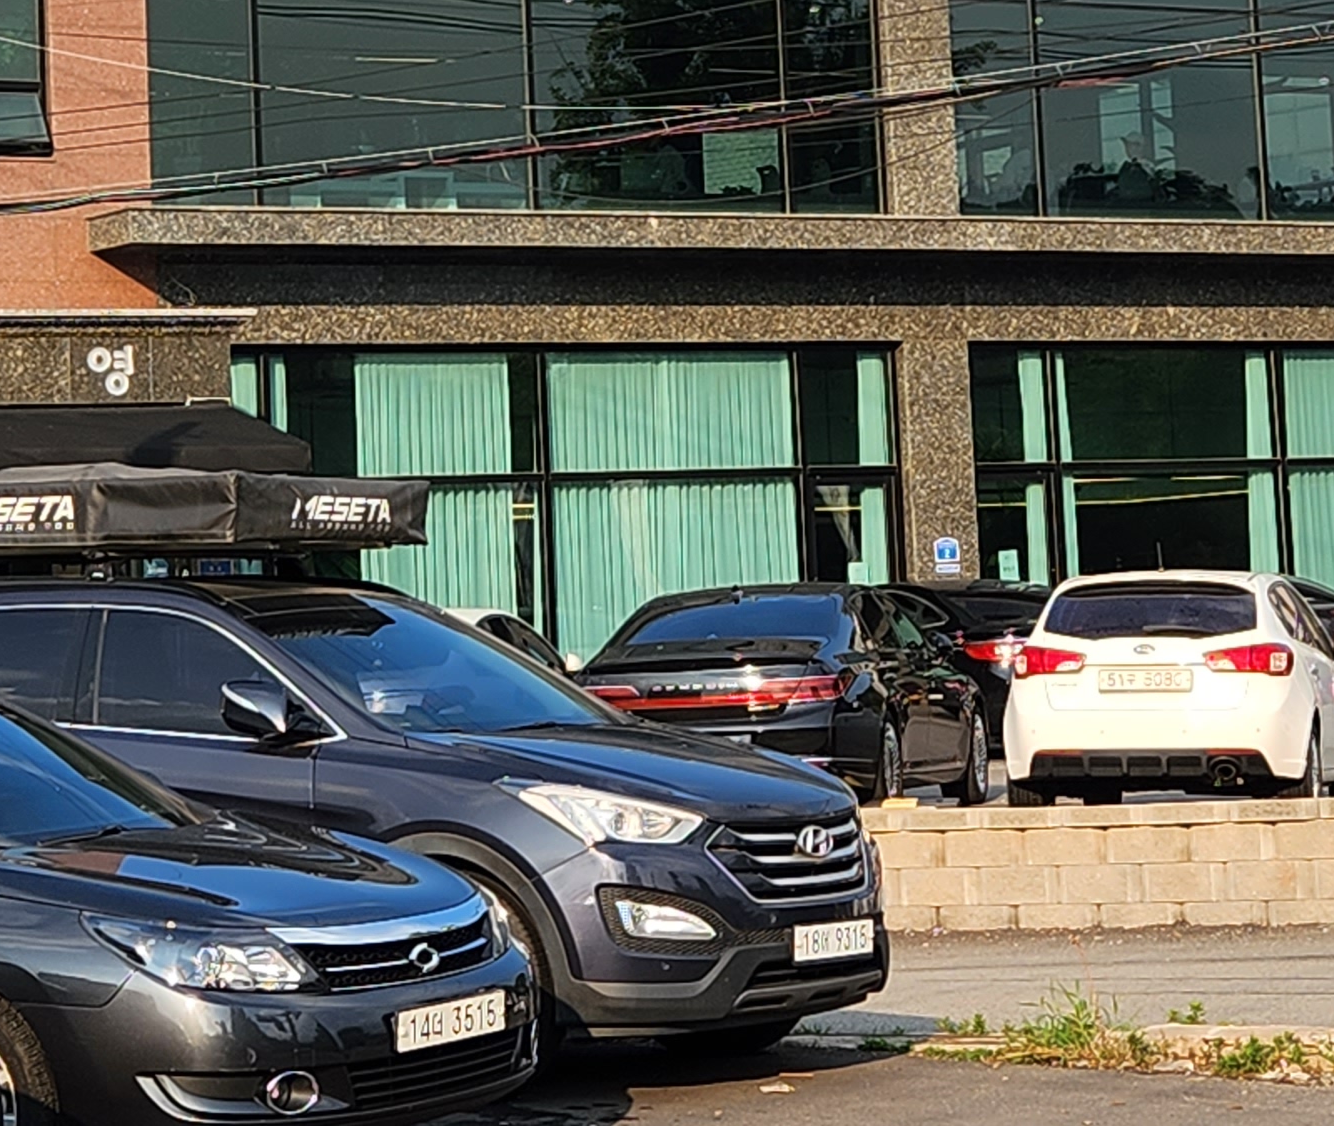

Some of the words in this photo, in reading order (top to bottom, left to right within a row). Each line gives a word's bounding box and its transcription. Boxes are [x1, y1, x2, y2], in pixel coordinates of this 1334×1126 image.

[291, 492, 392, 523] MESETA
[835, 923, 867, 952] 9315
[451, 998, 497, 1035] 3515
